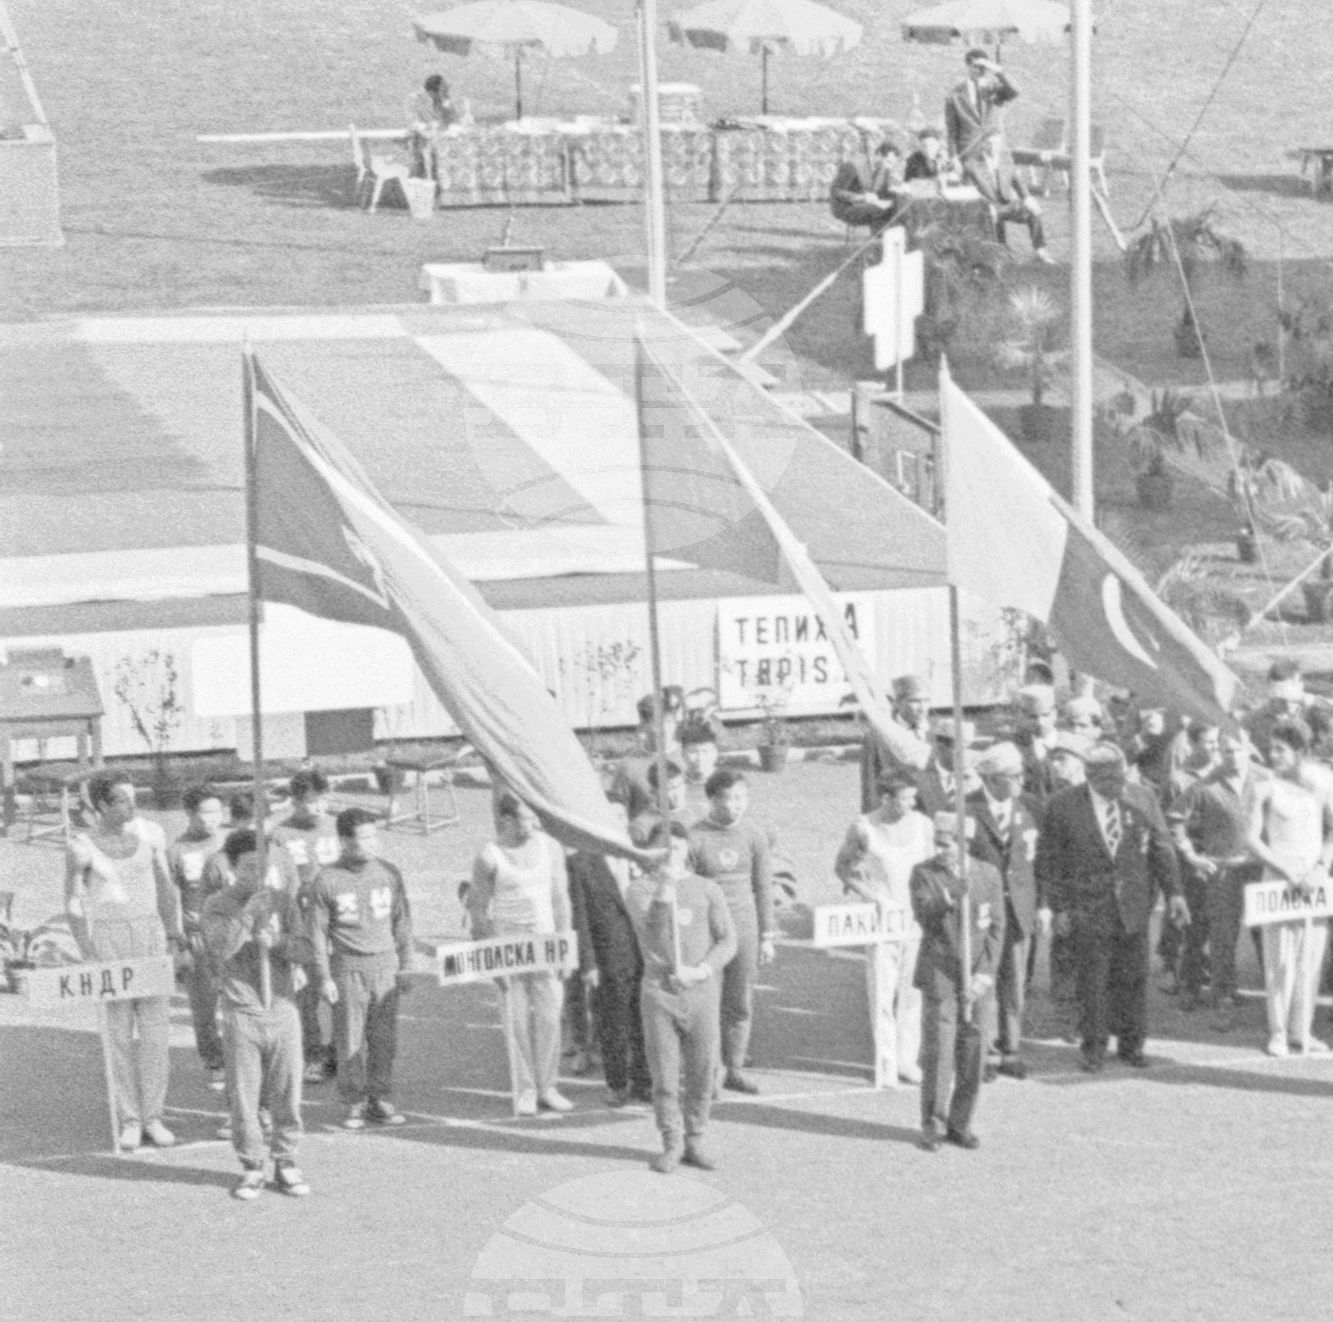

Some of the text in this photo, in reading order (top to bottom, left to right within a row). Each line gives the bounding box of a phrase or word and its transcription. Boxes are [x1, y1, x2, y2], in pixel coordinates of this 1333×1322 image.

[735, 614, 827, 645] ТЕПИХ
[735, 656, 828, 687] TAPIS
[828, 908, 905, 935] ПАКИСТ
[444, 940, 569, 977] МОНГОЛСКА НР
[60, 967, 134, 998] КНДР
